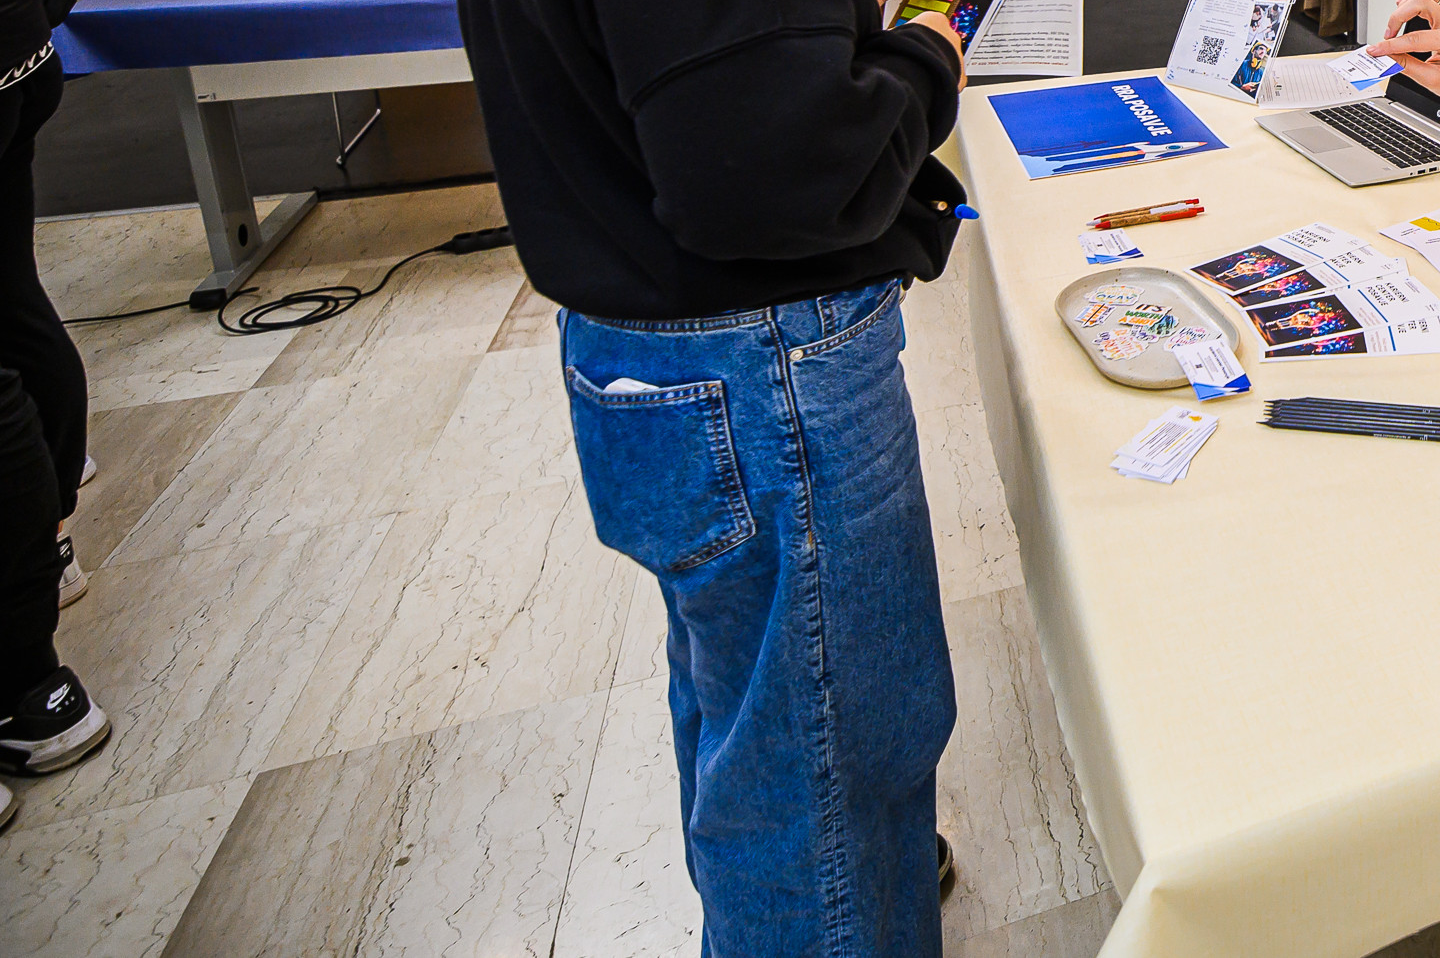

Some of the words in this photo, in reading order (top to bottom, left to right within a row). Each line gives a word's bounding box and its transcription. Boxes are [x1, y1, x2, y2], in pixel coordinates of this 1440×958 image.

[1111, 84, 1139, 101] RRA
[1124, 99, 1173, 137] POSAVJE
[1125, 310, 1163, 320] WORTH
